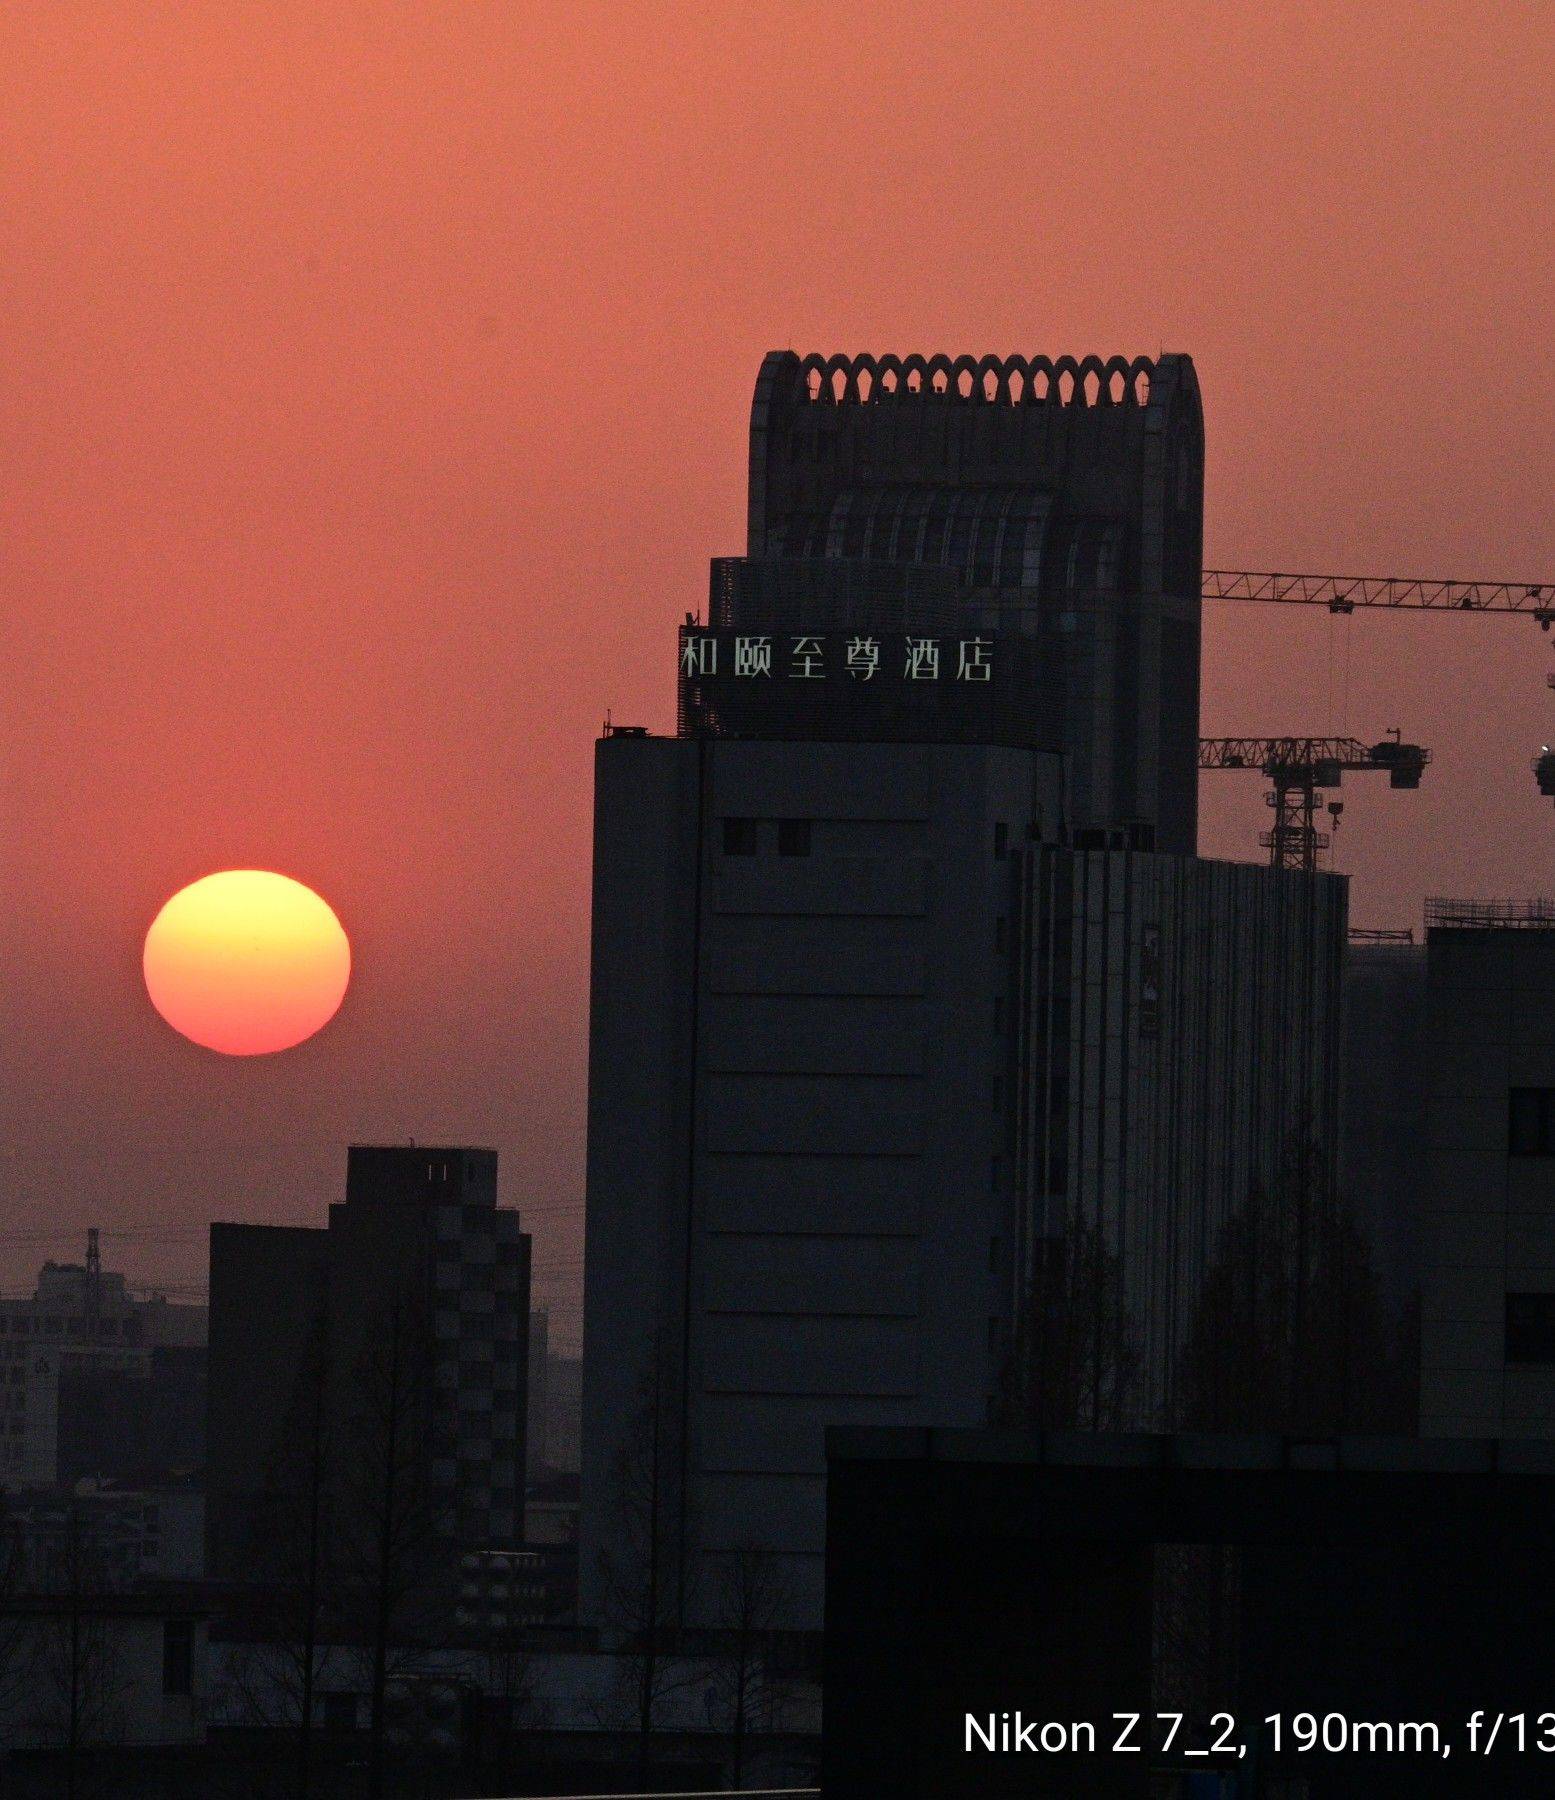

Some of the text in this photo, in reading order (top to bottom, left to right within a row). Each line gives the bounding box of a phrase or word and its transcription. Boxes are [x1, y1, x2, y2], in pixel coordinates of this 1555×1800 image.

[680, 636, 993, 681] 和颐至尊酒店
